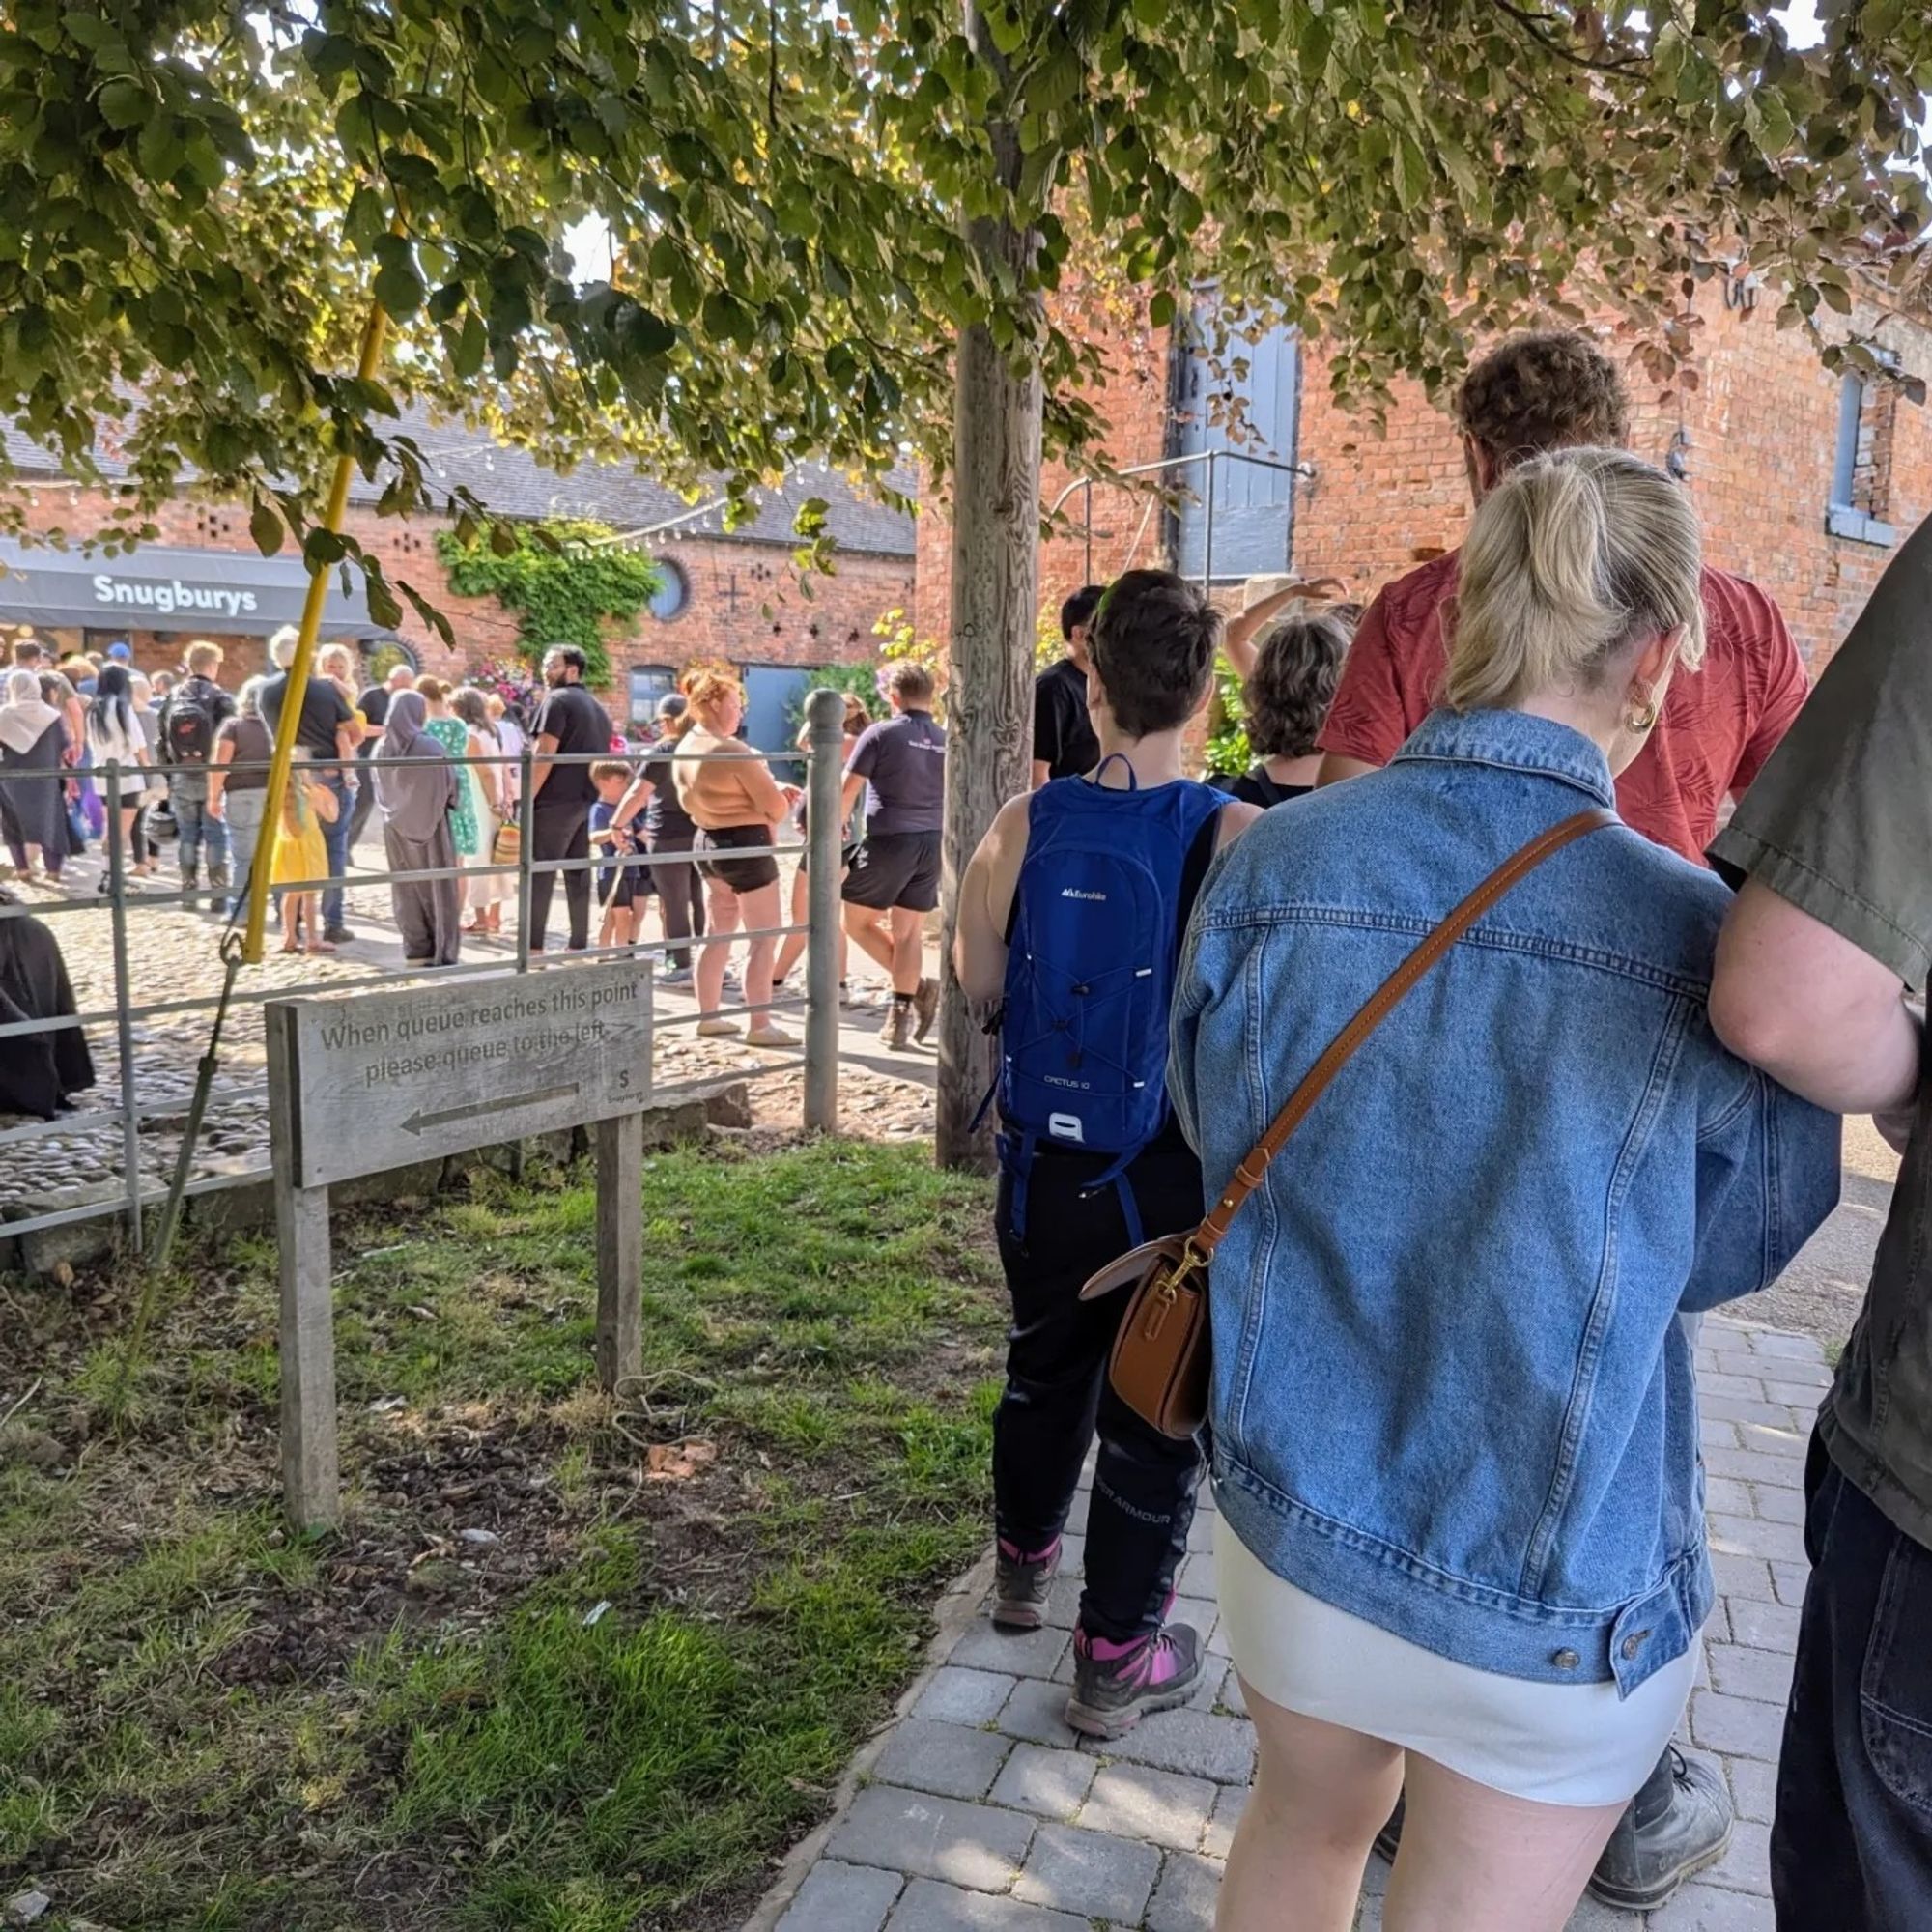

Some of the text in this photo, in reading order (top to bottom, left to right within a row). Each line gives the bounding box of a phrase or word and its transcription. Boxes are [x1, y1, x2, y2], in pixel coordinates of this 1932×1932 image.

[93, 574, 258, 616] Snugburys
[320, 981, 639, 1050] When queue reaches this point
[366, 1019, 606, 1088] please queue to the left
[619, 1069, 629, 1089] S
[1044, 1074, 1079, 1088] CACTUS
[1113, 1496, 1171, 1524] ARMOUR
